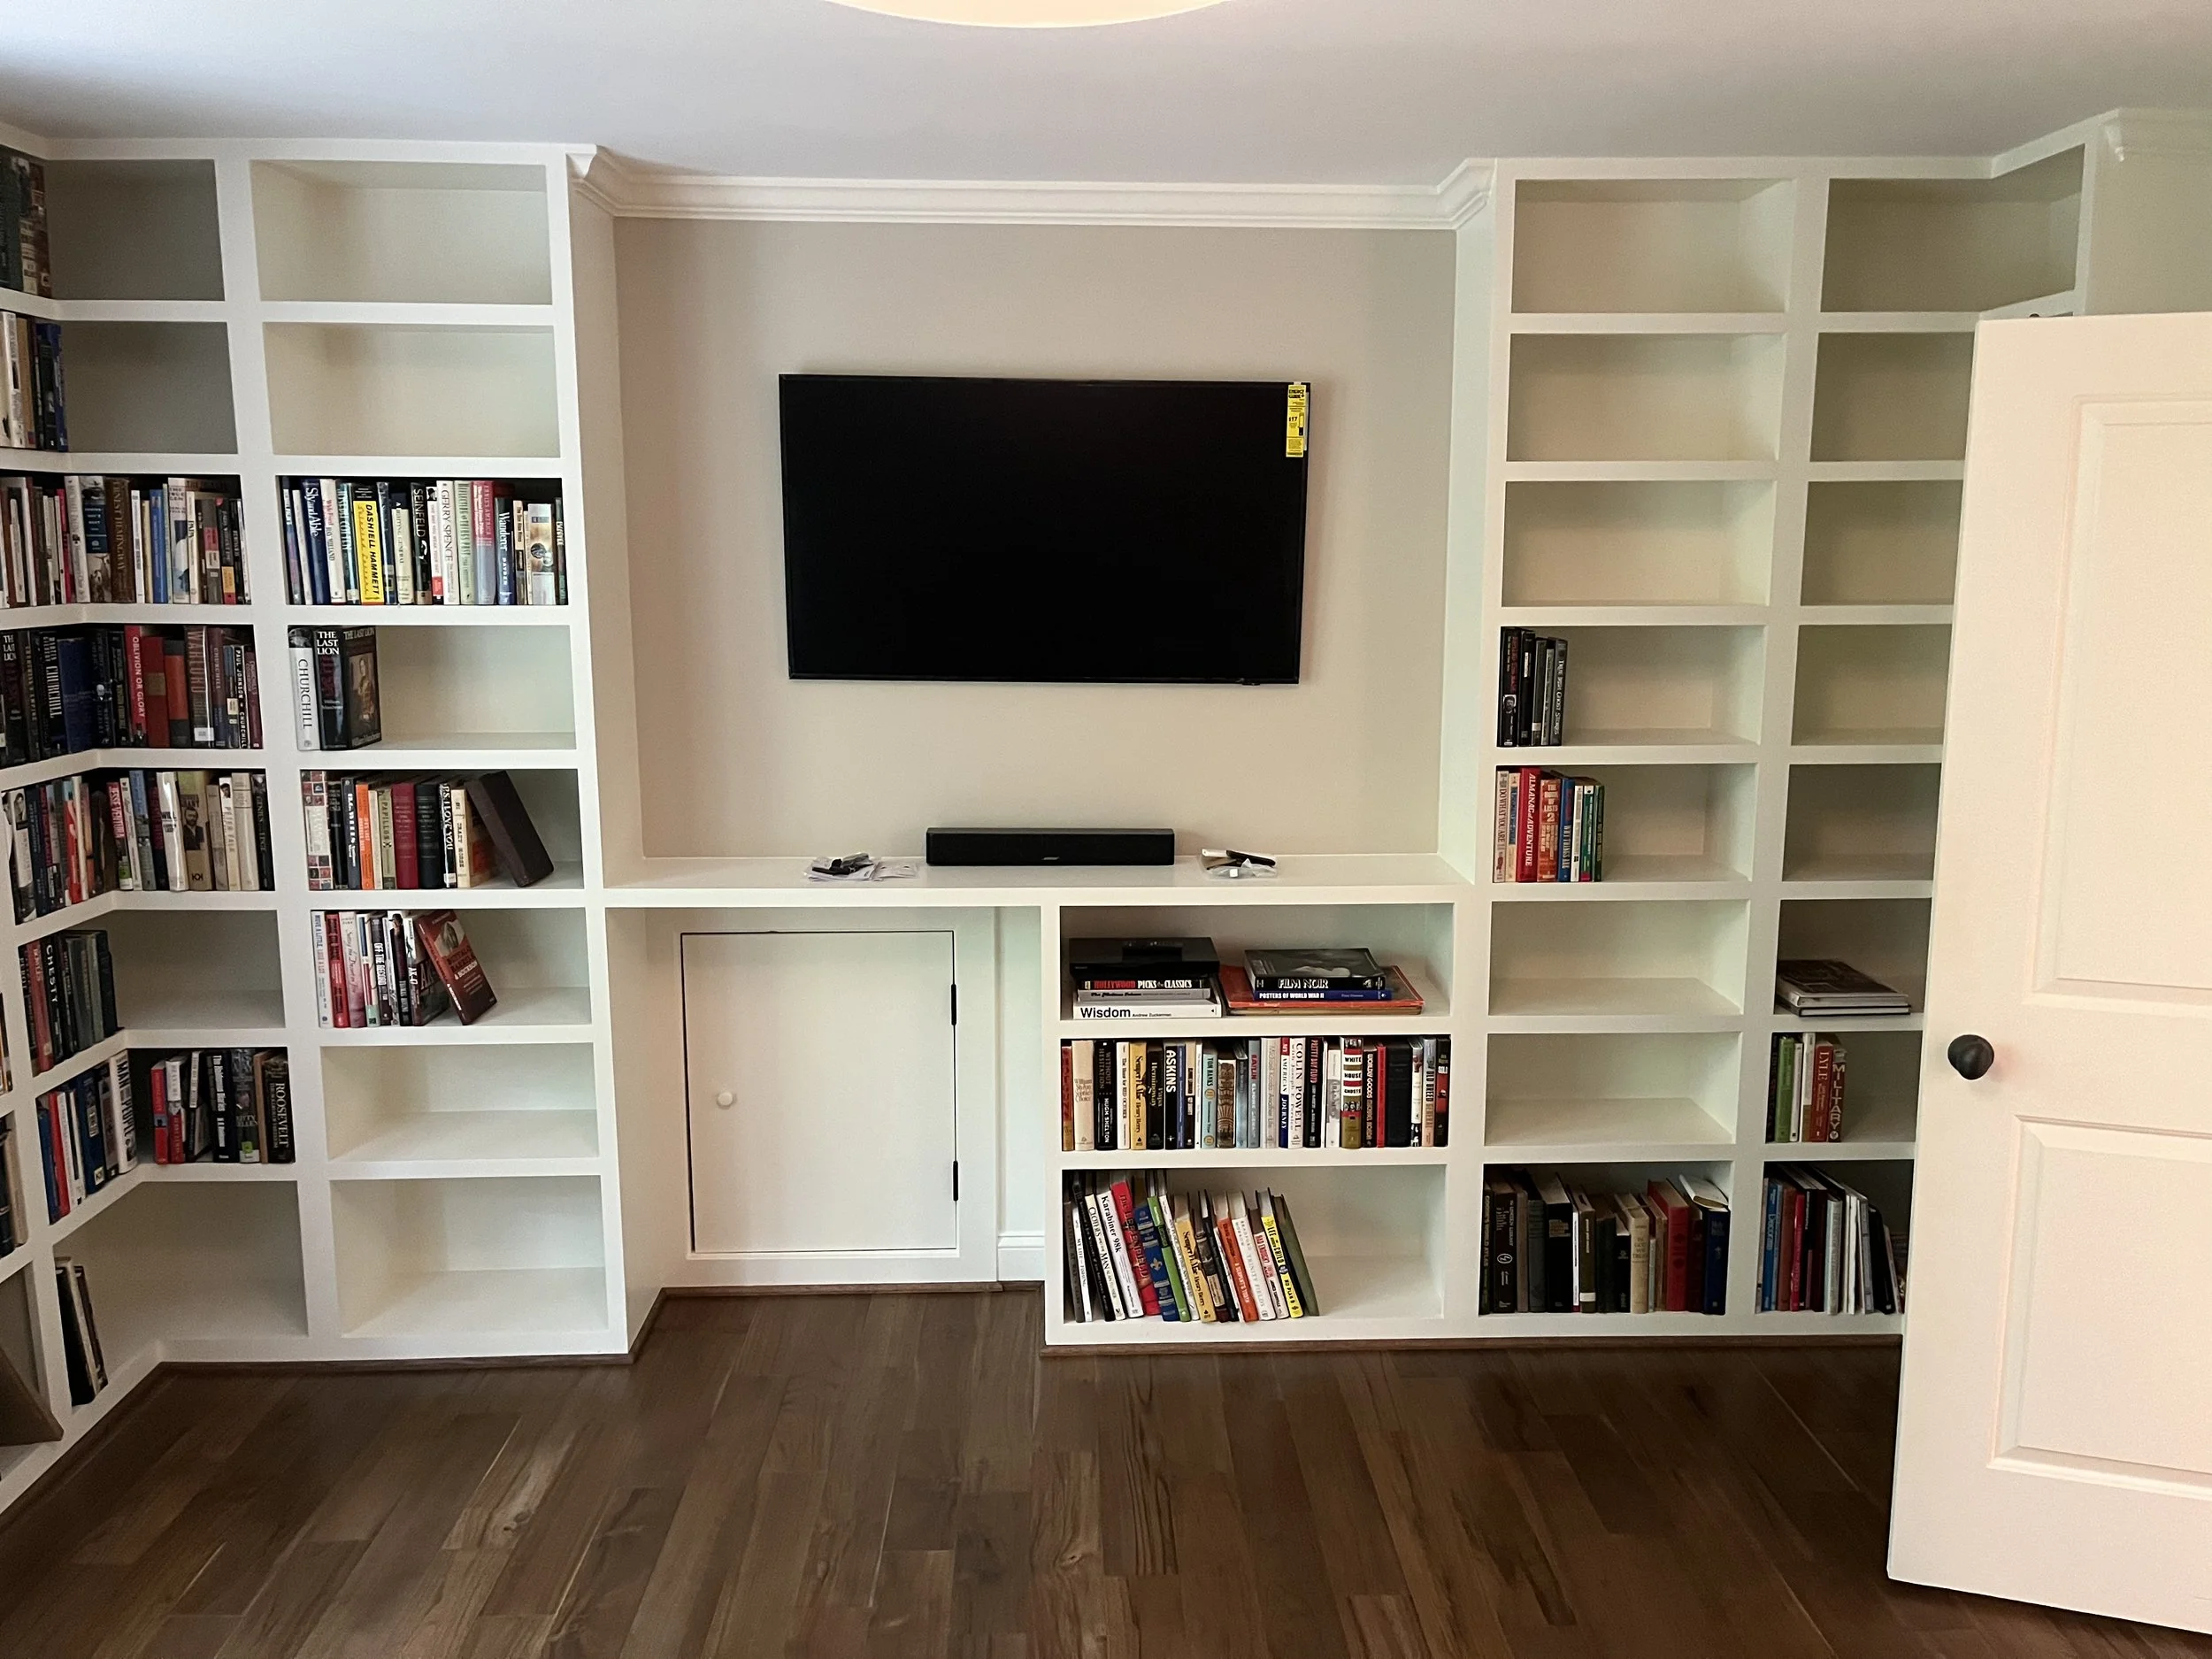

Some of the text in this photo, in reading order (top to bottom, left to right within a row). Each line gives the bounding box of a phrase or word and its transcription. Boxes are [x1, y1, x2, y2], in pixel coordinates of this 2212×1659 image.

[305, 488, 321, 536] Sly and Able
[413, 488, 426, 537] SEINFELD
[441, 489, 453, 561] GERRY SPENCE
[499, 512, 511, 551] Wanderer
[366, 504, 379, 595] DASHIELL HAMMETT
[133, 637, 142, 675] OBLIVION
[187, 631, 205, 694] WARLORD
[45, 665, 62, 718] CHURCHILL
[135, 678, 142, 689] OR
[298, 659, 312, 729] CHURCHILL
[108, 786, 125, 838] JESSE VENTURA
[442, 783, 451, 799] P.S.
[380, 801, 390, 841] PAPILLON
[1547, 812, 1555, 822] 2
[1525, 818, 1534, 866] ADVENTURE
[46, 944, 58, 1002] CHESTY
[349, 956, 357, 977] Desert
[374, 942, 387, 986] OFF THE RECORD
[408, 967, 417, 985] AK-47
[1278, 979, 1329, 988] FILM NOIR
[1080, 1007, 1131, 1018] Wisdom
[1133, 1056, 1143, 1079] Semper
[1282, 1043, 1288, 1053] MY
[1817, 1051, 1830, 1080] LYLE
[1165, 1050, 1177, 1093] ASKINS
[1425, 1084, 1434, 1102] BREED
[116, 1062, 135, 1137] MAN PEOPLE
[275, 1083, 289, 1148] ROOSEVELT
[1425, 1103, 1434, 1128] GENERAL
[1830, 1064, 1845, 1130] MILITARY
[1077, 1238, 1082, 1247] MY
[1087, 1207, 1102, 1237] CLOTHES
[1100, 1253, 1109, 1270] MAN
[1101, 1195, 1122, 1253] Karabiner 98k
[1235, 1222, 1244, 1246] MORROW
[1240, 1220, 1252, 1252] BRADFORD
[1267, 1226, 1285, 1263] LEE CHILD
[1182, 1232, 1194, 1256] Semper
[1194, 1276, 1202, 1292] Henry
[1226, 1238, 1235, 1257] JOHNSON
[1235, 1267, 1246, 1289] SERPENT'S
[1247, 1255, 1264, 1307] TRINITY FIELDS
